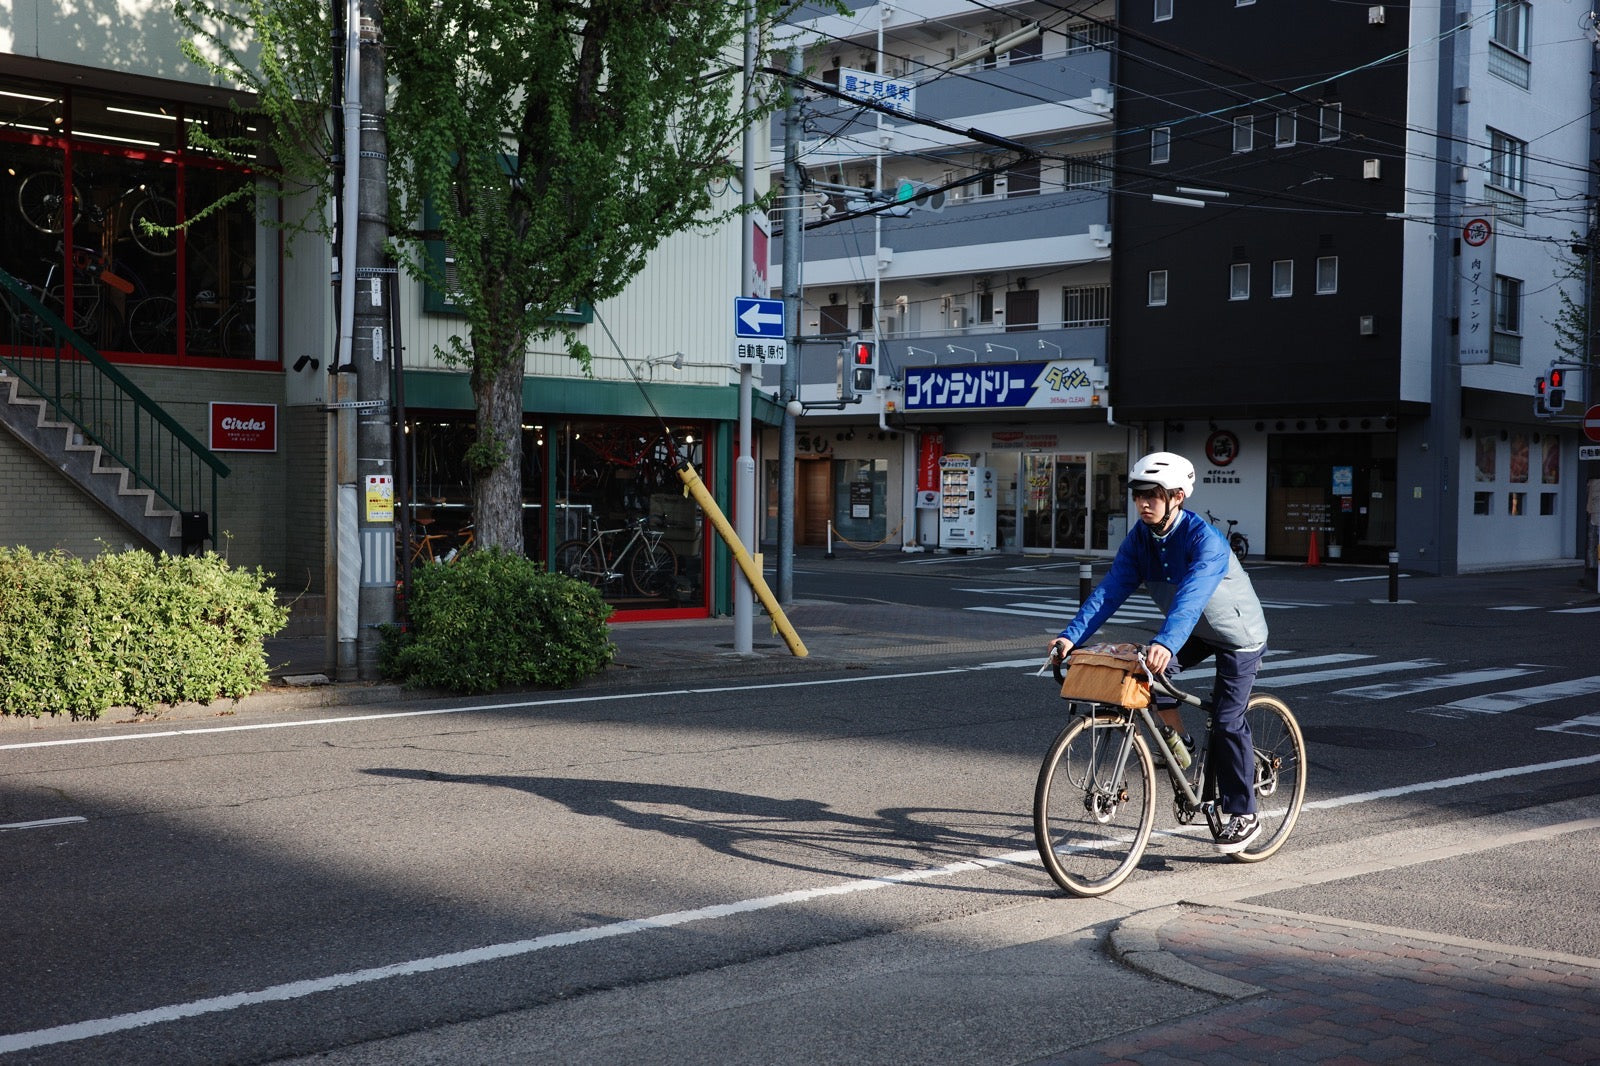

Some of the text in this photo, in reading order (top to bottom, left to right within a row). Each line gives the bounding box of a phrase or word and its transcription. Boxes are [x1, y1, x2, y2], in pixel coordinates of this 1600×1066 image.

[845, 75, 910, 102] 富士見橋東
[1470, 224, 1486, 240] 満
[1471, 258, 1481, 334] 肉ダイニング
[907, 370, 1025, 405] コインランドリー
[1045, 366, 1091, 392] ダッシュ
[1068, 395, 1086, 403] CLEAN
[221, 416, 266, 431] Circles
[1203, 475, 1240, 483] mitasu
